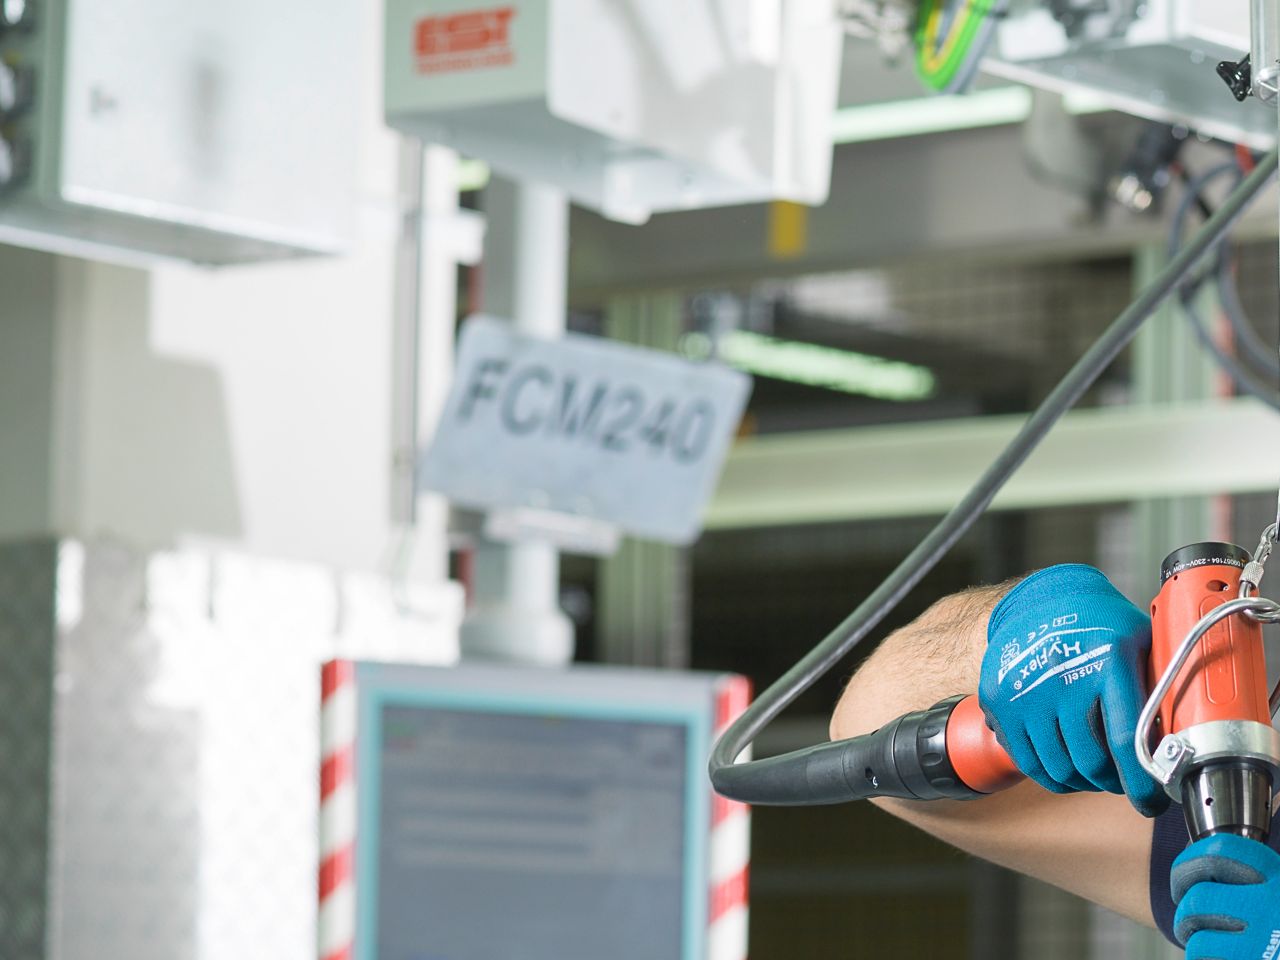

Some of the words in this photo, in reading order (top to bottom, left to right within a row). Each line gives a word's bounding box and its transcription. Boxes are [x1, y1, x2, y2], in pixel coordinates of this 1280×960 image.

[456, 357, 718, 466] FCM240
[1019, 640, 1082, 680] HyFlex
[1063, 659, 1105, 686] Ansell
